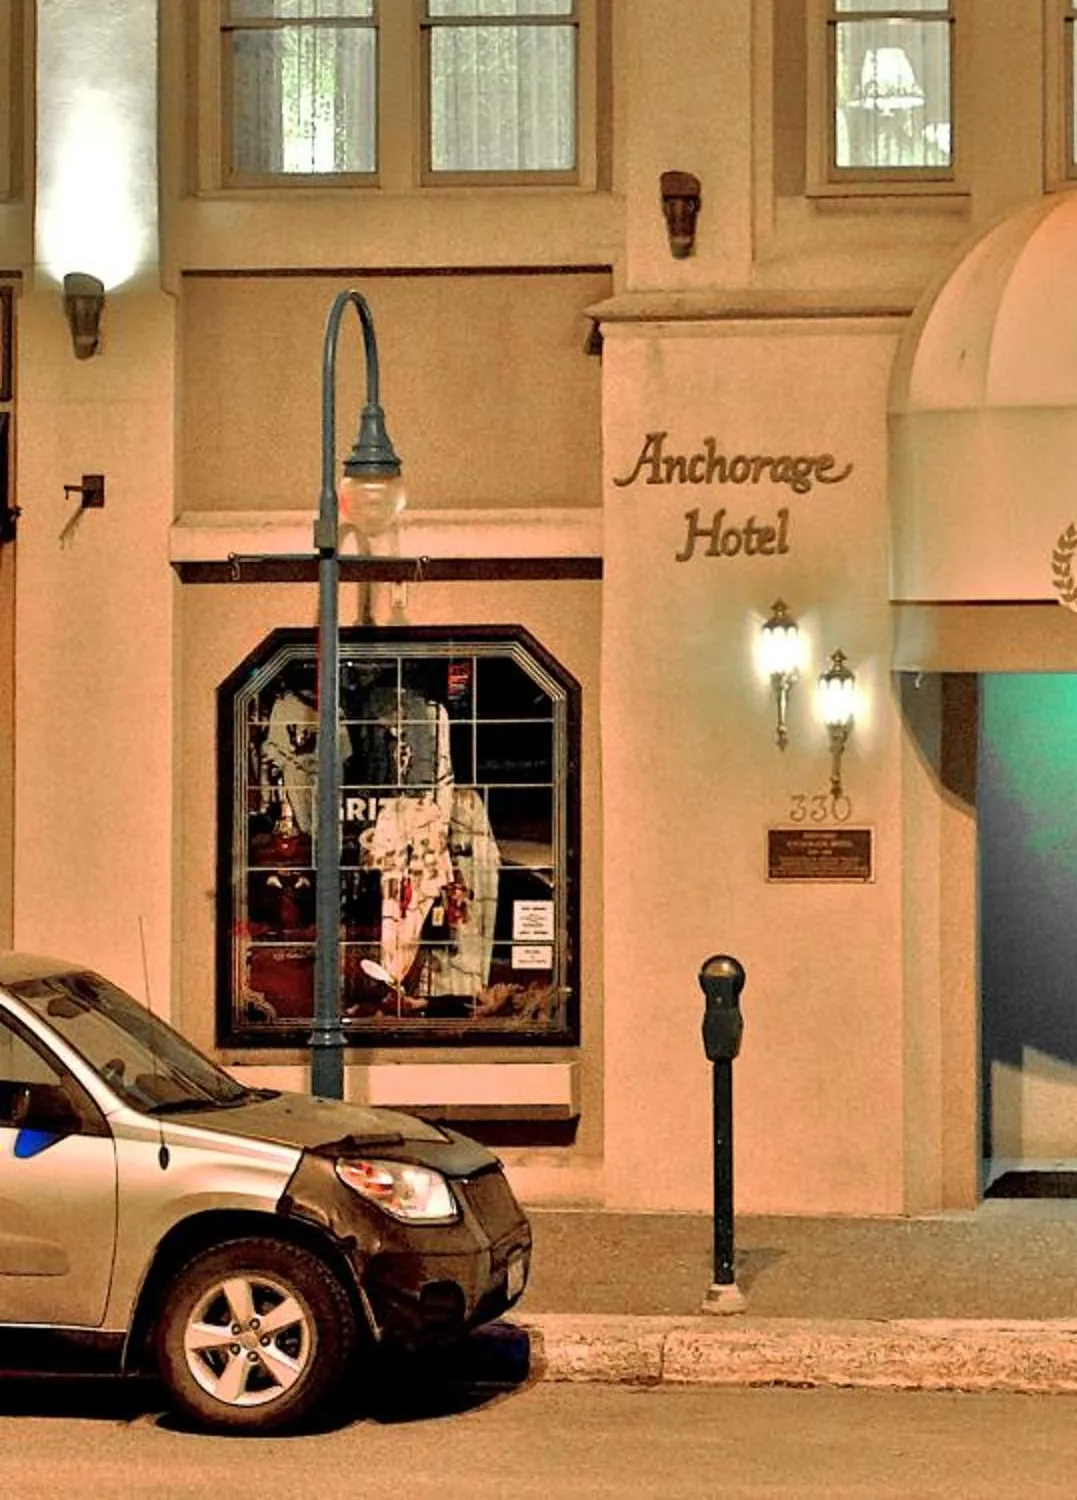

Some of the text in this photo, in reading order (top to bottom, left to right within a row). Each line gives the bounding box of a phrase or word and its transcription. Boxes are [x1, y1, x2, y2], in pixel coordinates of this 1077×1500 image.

[613, 431, 853, 494] Anchorage
[675, 507, 789, 562] Hotel
[789, 794, 851, 822] 330
